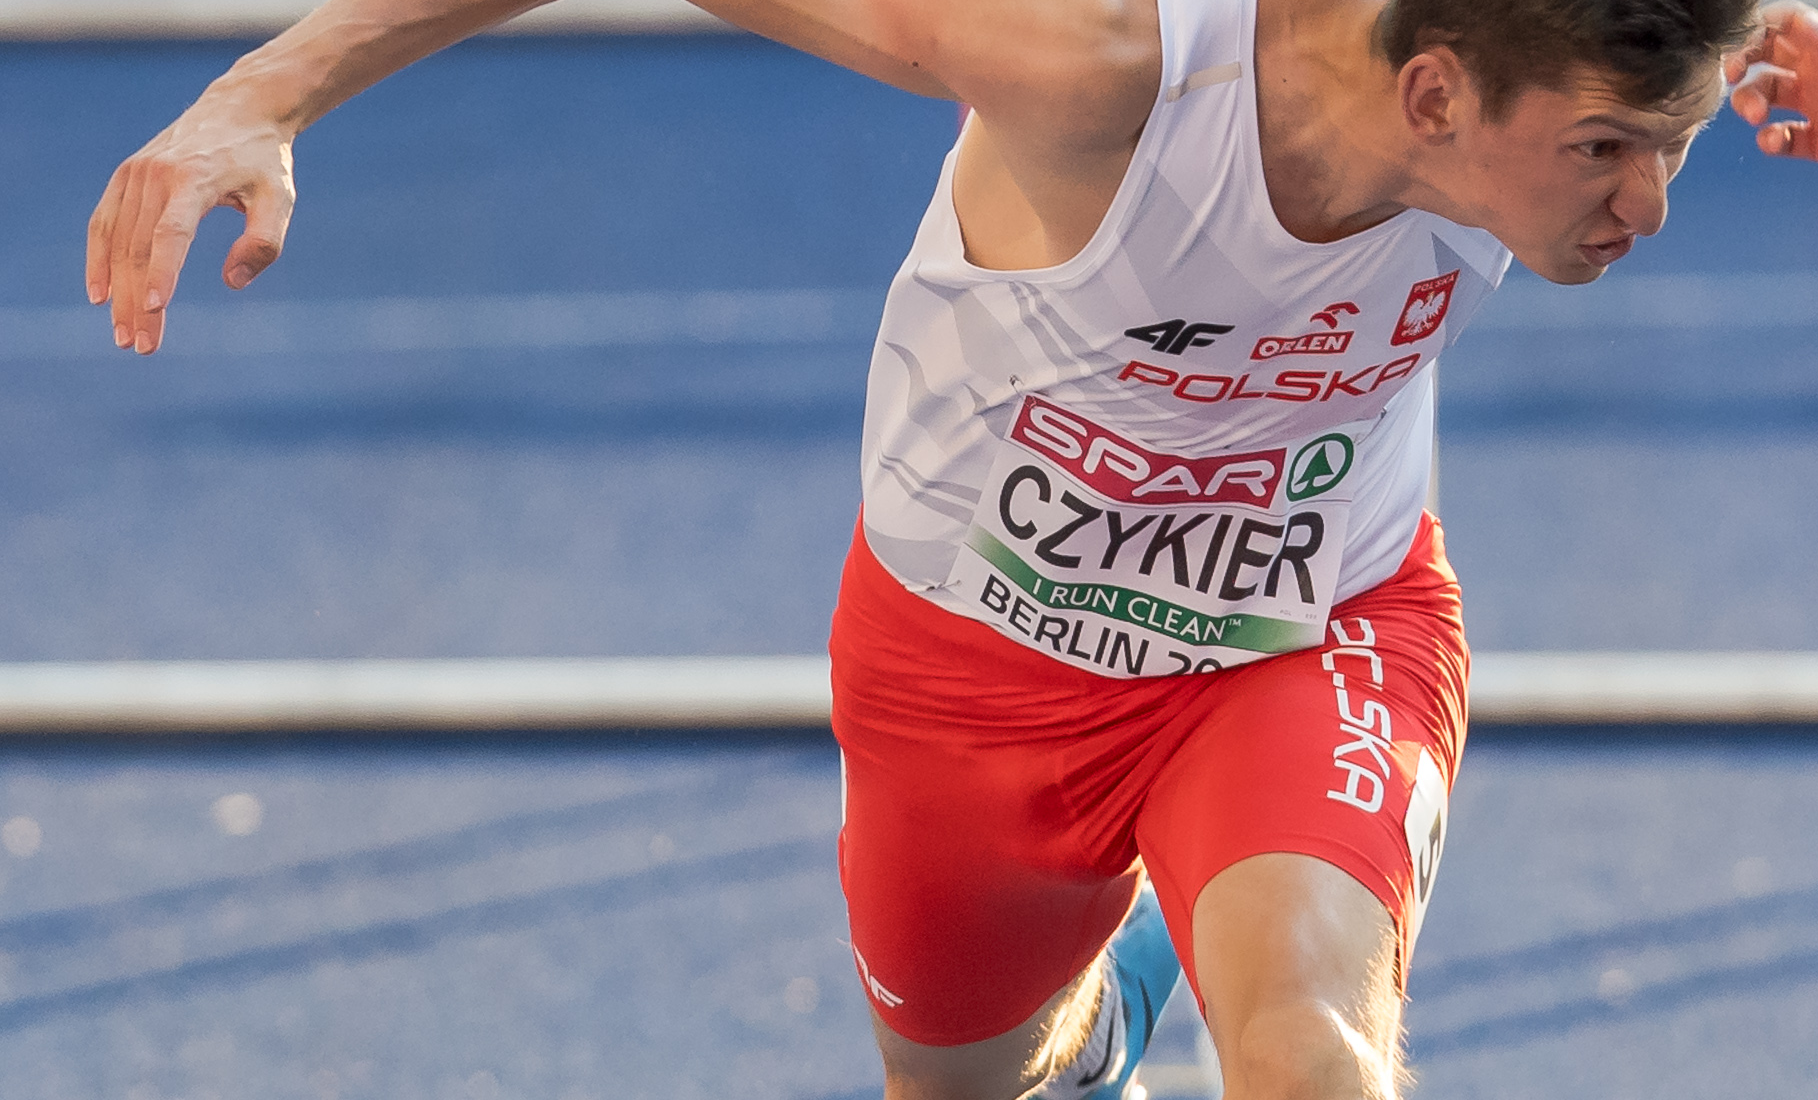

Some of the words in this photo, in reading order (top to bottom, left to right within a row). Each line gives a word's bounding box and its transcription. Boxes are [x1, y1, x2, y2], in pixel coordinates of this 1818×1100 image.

[1123, 317, 1236, 356] 4F
[1257, 334, 1348, 358] ORLEN
[1117, 352, 1422, 403] POLSKA
[1022, 405, 1277, 497] SPAR
[998, 464, 1326, 605] CZYKIER
[1032, 578, 1042, 595] I
[1049, 585, 1119, 613] RUN
[979, 573, 1151, 677] BERLIN
